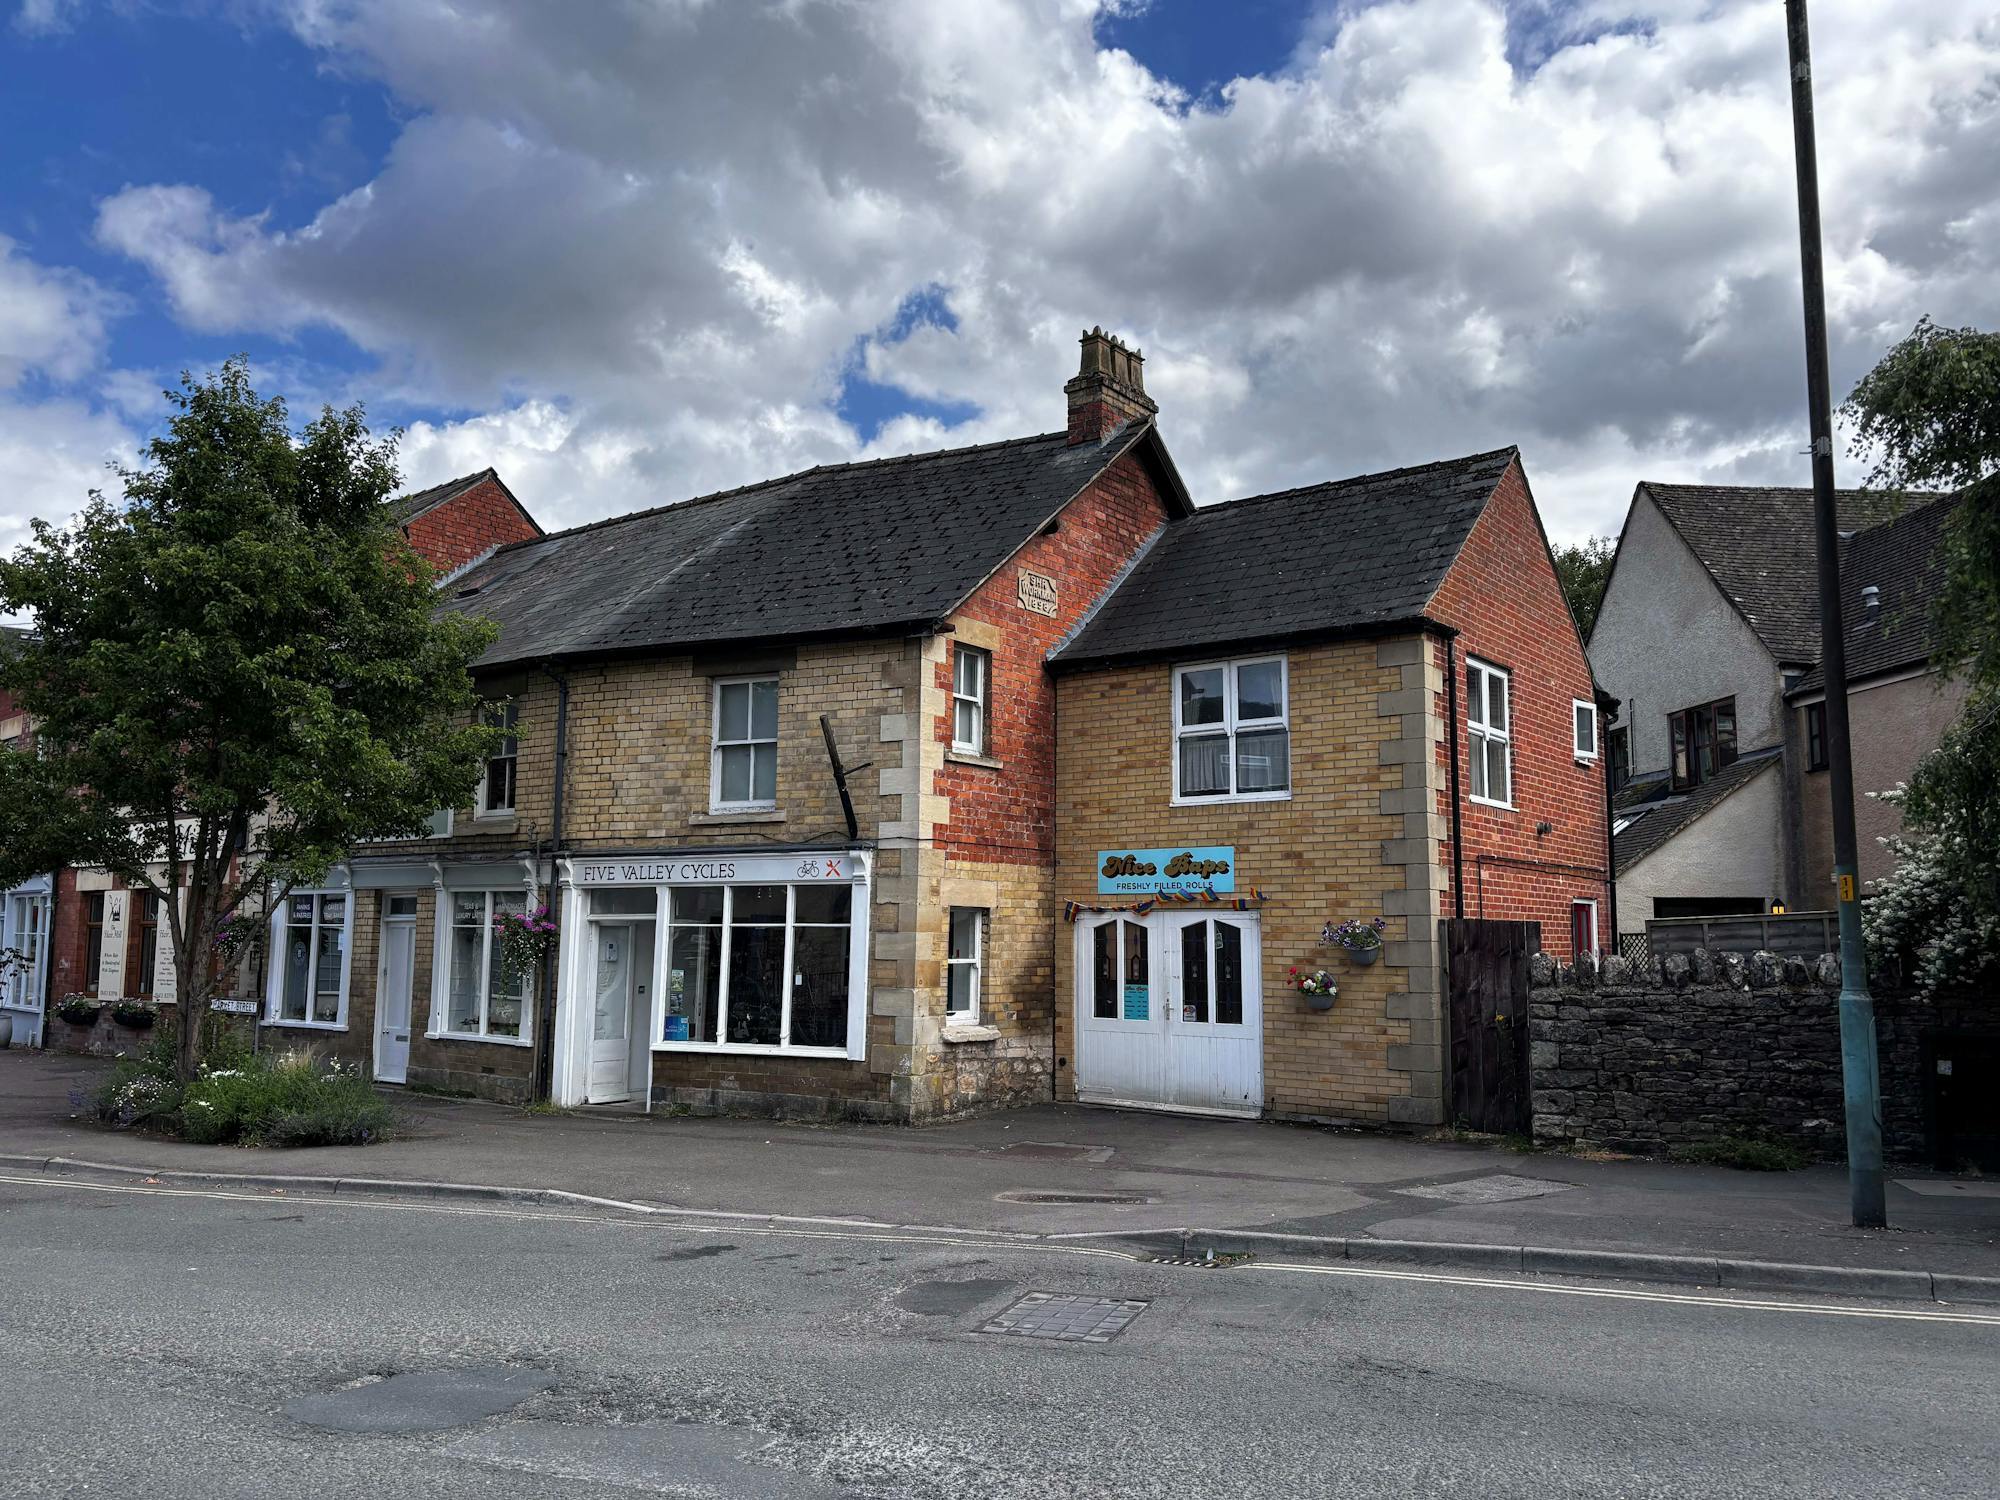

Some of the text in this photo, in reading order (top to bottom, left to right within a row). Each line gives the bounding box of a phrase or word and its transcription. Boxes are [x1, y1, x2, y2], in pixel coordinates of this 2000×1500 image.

[584, 863, 735, 880] FIVE VALLEY CYCLES
[1101, 851, 1230, 880] Nice Baps
[1116, 881, 1214, 890] FRESHLY FILLED ROLLS
